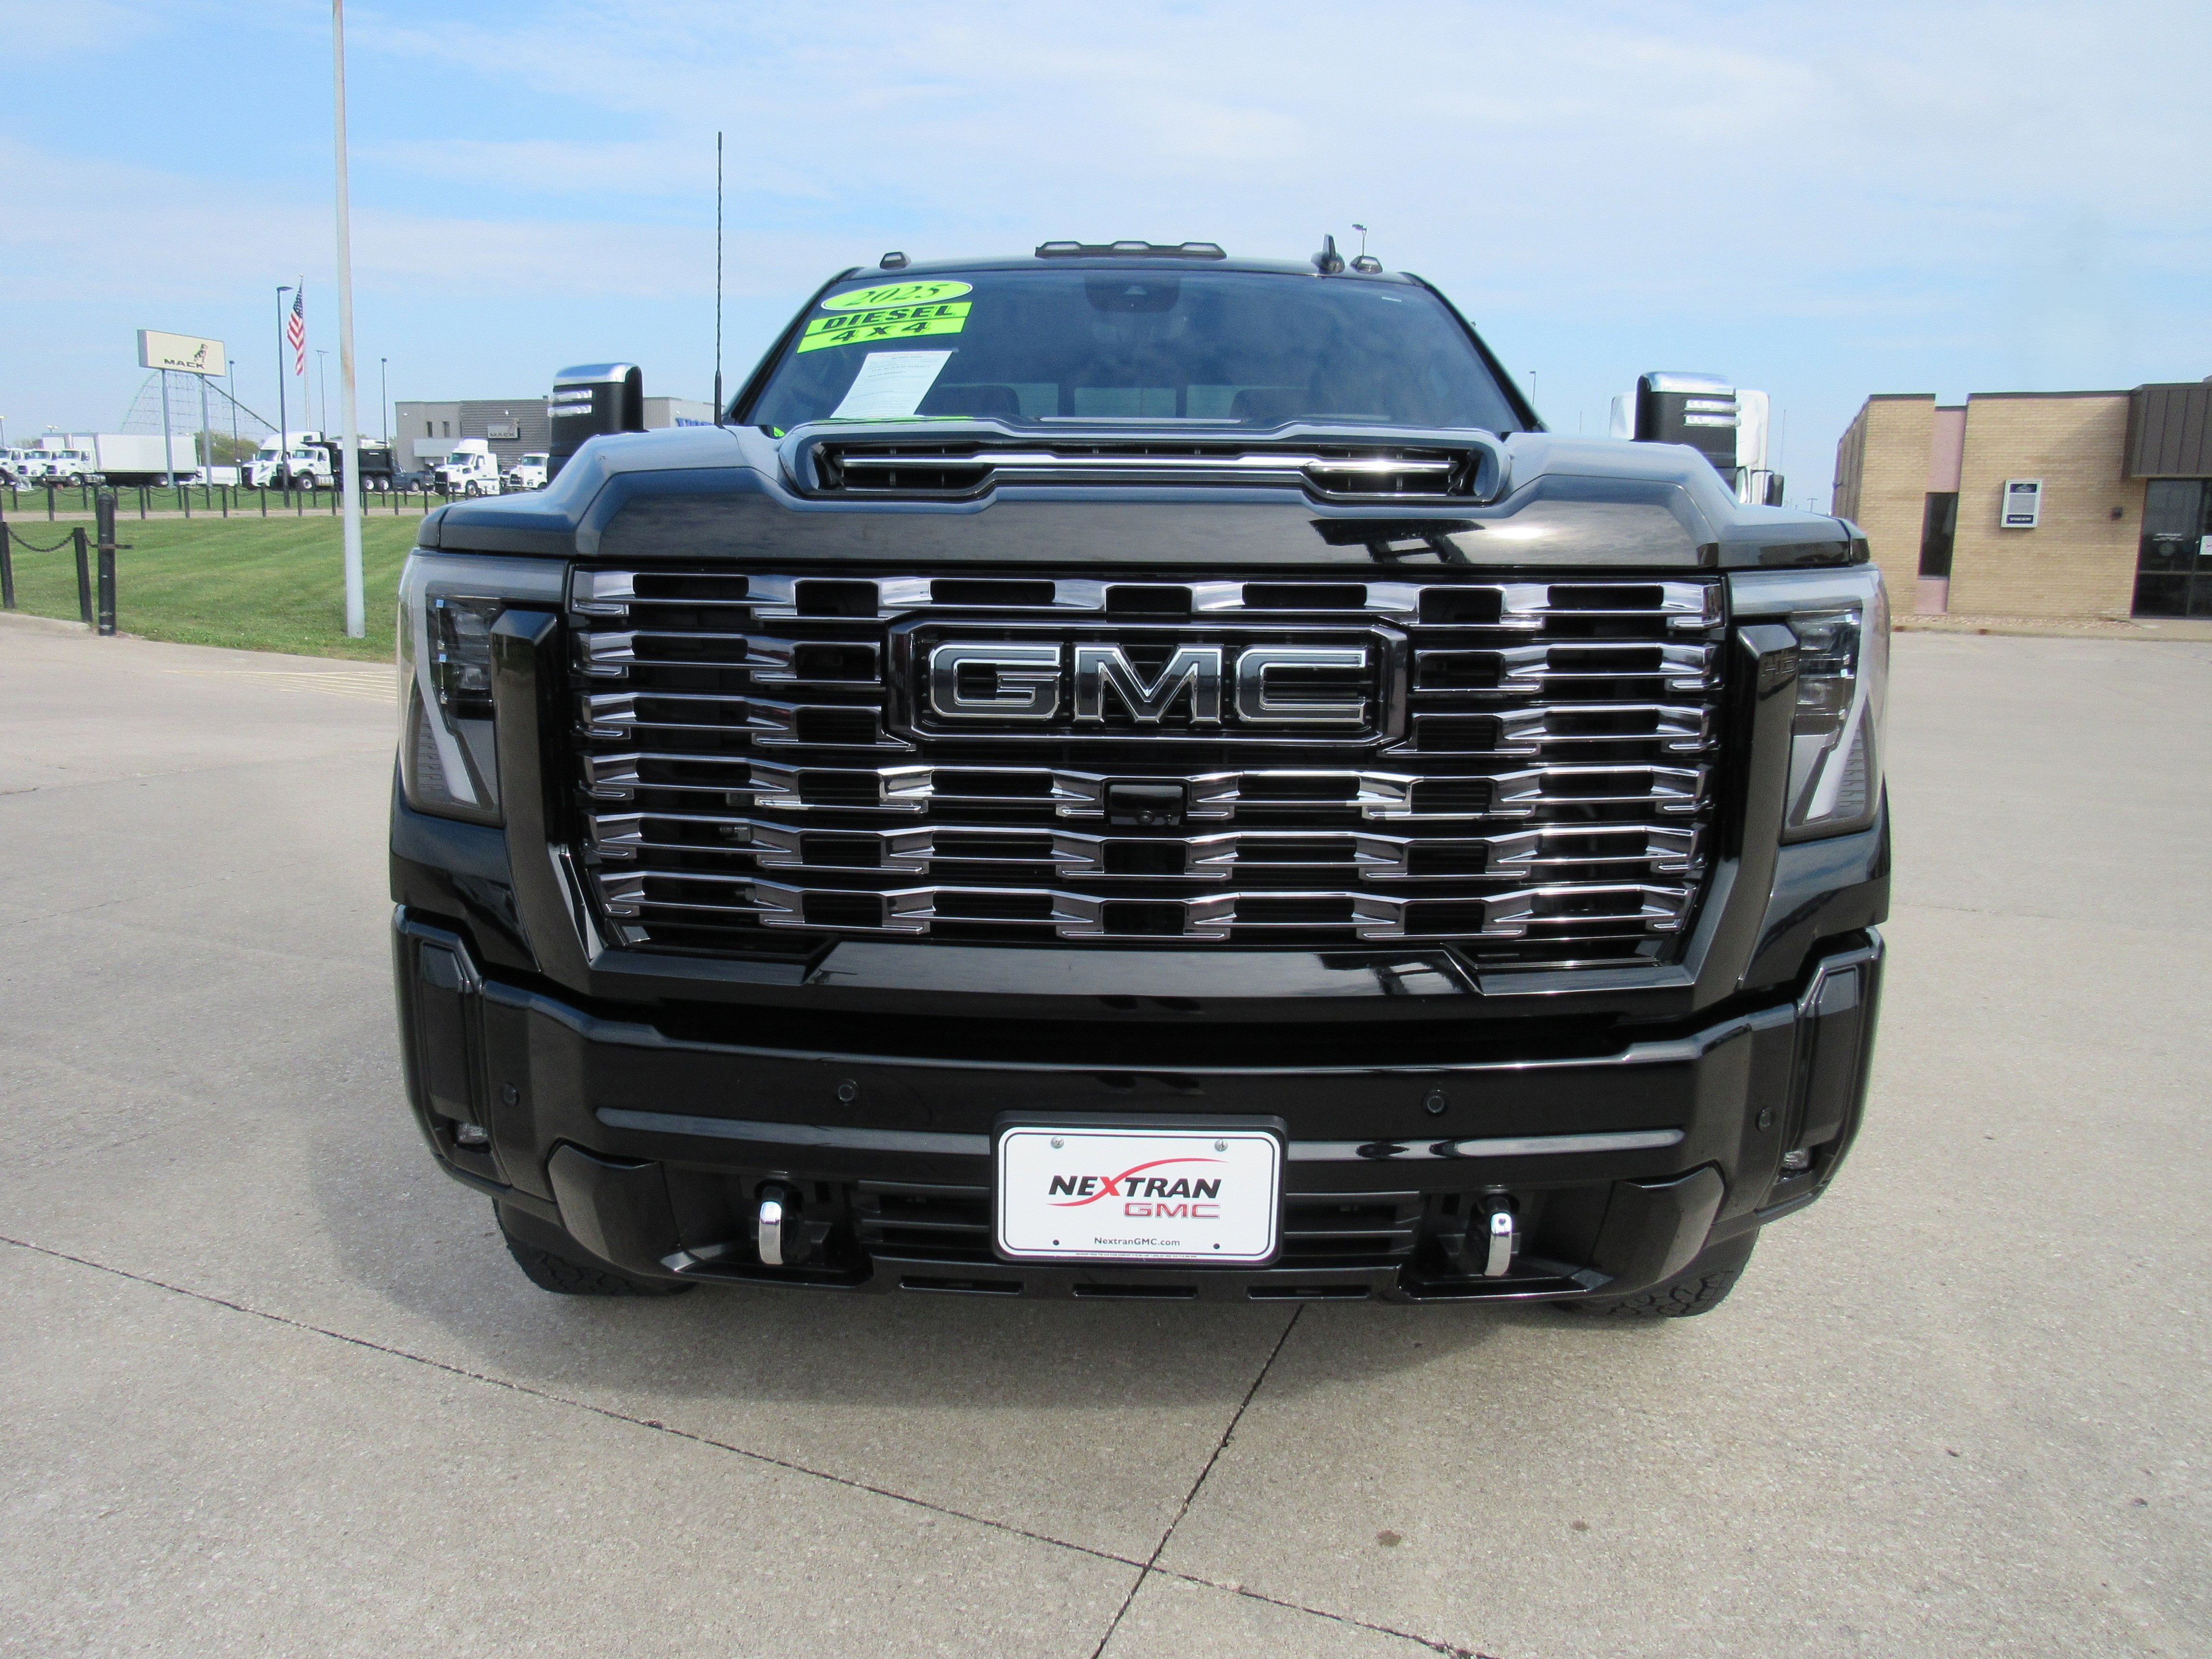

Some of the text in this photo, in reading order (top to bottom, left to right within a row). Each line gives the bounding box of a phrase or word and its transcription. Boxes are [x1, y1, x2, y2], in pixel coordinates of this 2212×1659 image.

[842, 284, 949, 307] 2025
[821, 305, 953, 331] DIESEL
[164, 358, 205, 369] MACK
[928, 641, 1368, 725] GMC
[1048, 1175, 1222, 1199] NEXTRAN
[1123, 1201, 1221, 1219] GMC
[1094, 1237, 1180, 1247] NextranGMC.com
